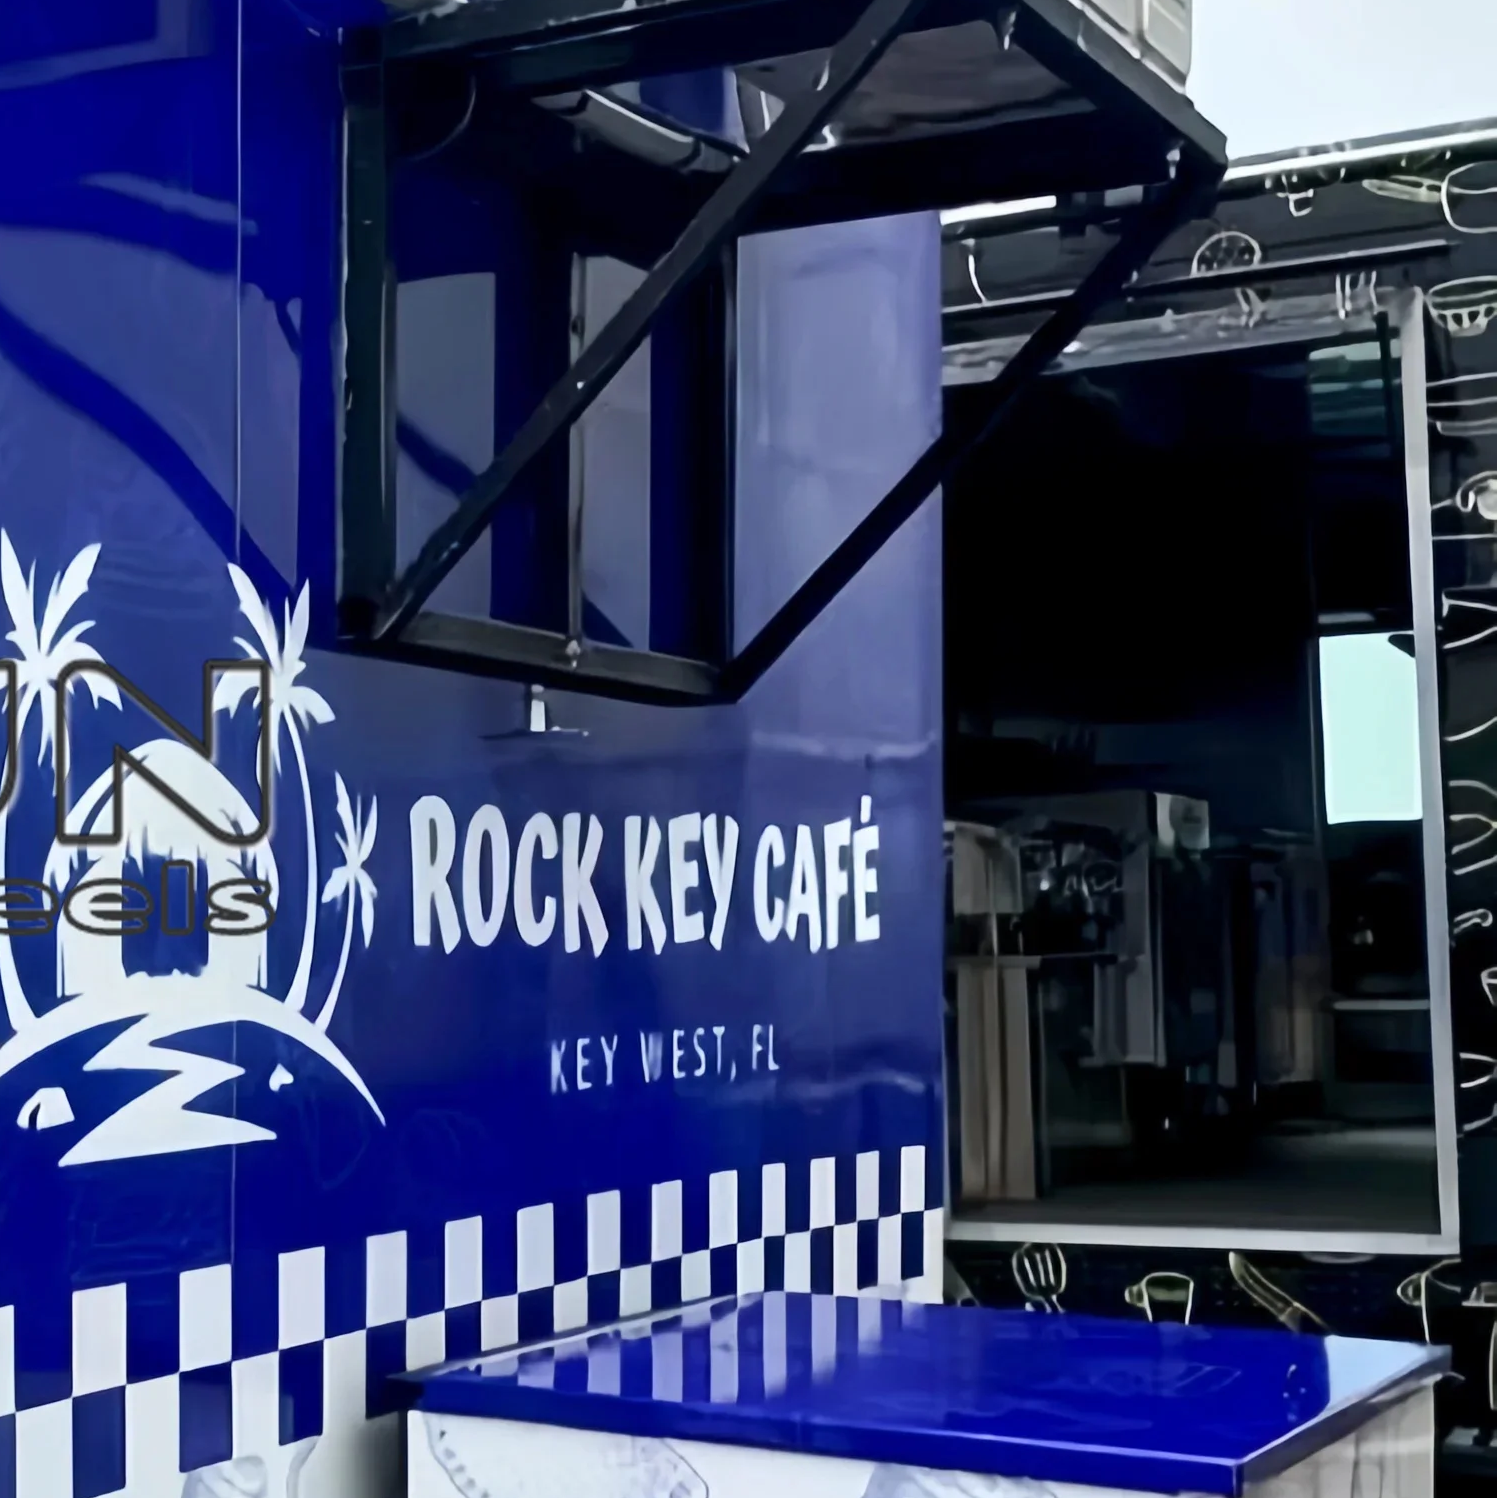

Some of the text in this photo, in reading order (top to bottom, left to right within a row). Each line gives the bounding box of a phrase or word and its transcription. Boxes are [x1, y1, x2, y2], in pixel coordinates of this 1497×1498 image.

[409, 794, 881, 958] ROCK KEY CAFÉ
[550, 1024, 780, 1095] KEY WEST, FL
